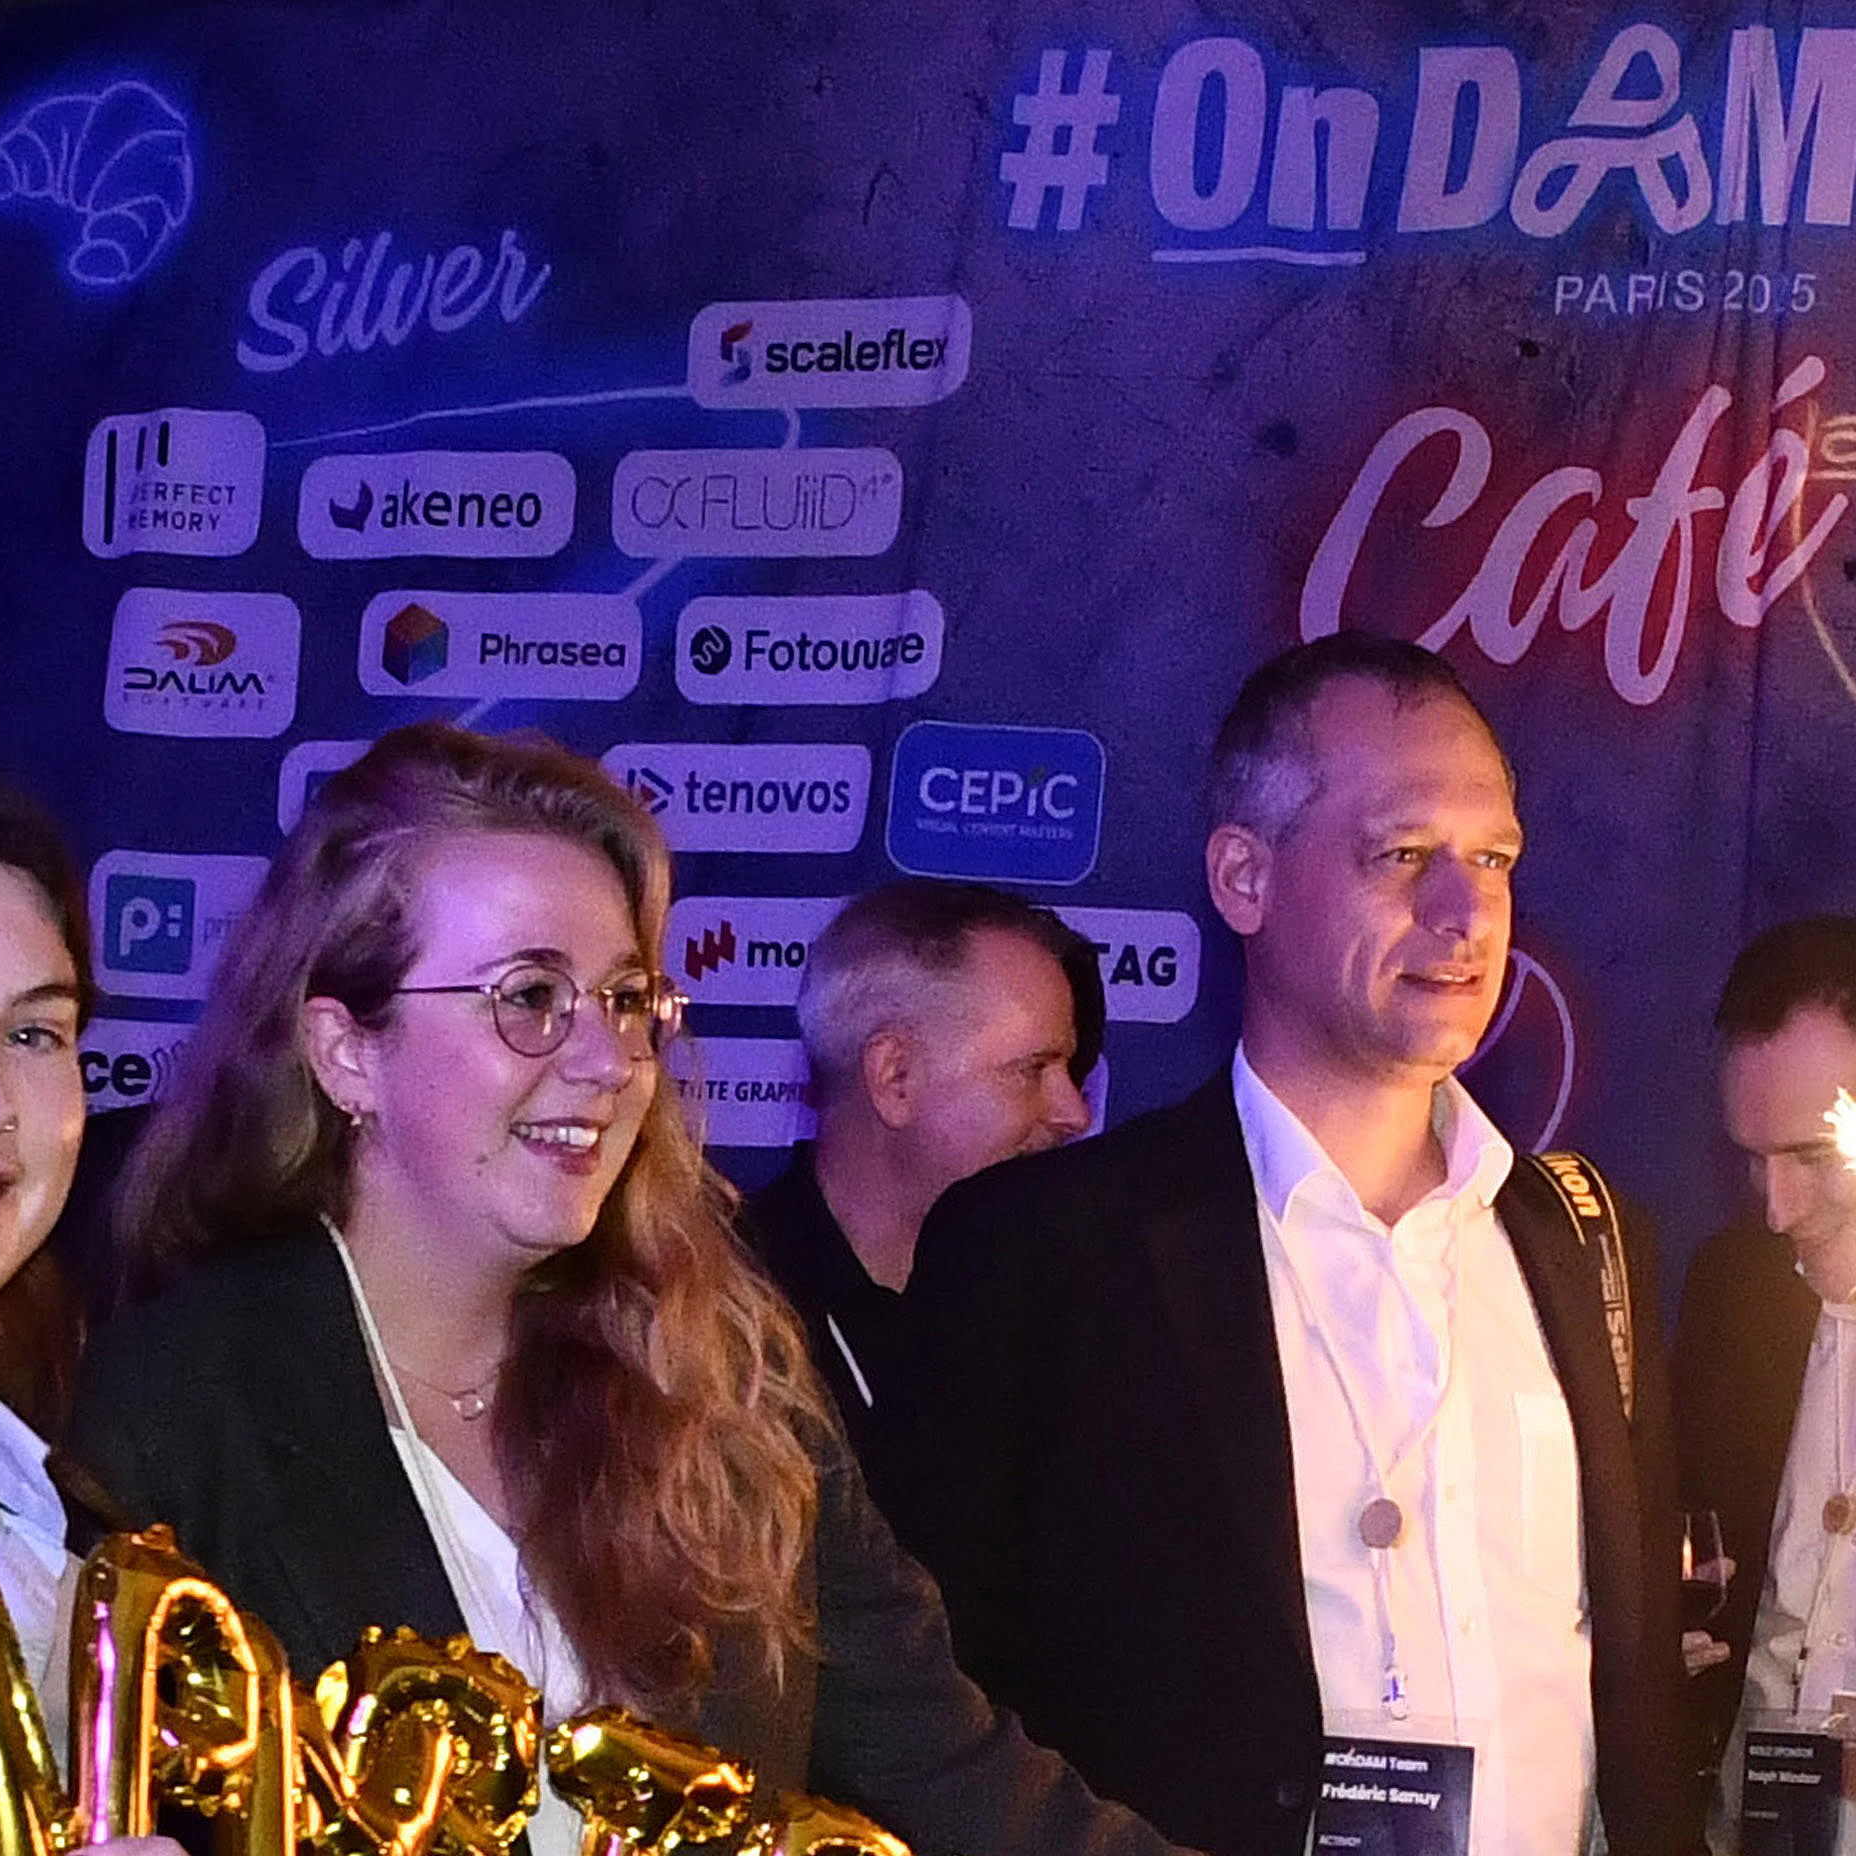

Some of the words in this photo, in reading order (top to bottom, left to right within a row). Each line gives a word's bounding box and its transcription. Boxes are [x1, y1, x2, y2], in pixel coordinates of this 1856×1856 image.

[237, 230, 551, 372] Silver
[1554, 270, 1705, 315] PARIS
[1723, 269, 1817, 313] 205
[764, 328, 949, 374] scaleflex
[380, 479, 543, 529] akeneo
[1301, 355, 1848, 702] Café
[479, 632, 627, 669] Phrasea
[123, 666, 265, 695] DALIM
[685, 769, 851, 816] tenovos
[1095, 943, 1178, 987] TAG
[1539, 1154, 1602, 1218] ikon
[1389, 1756, 1429, 1772] Team
